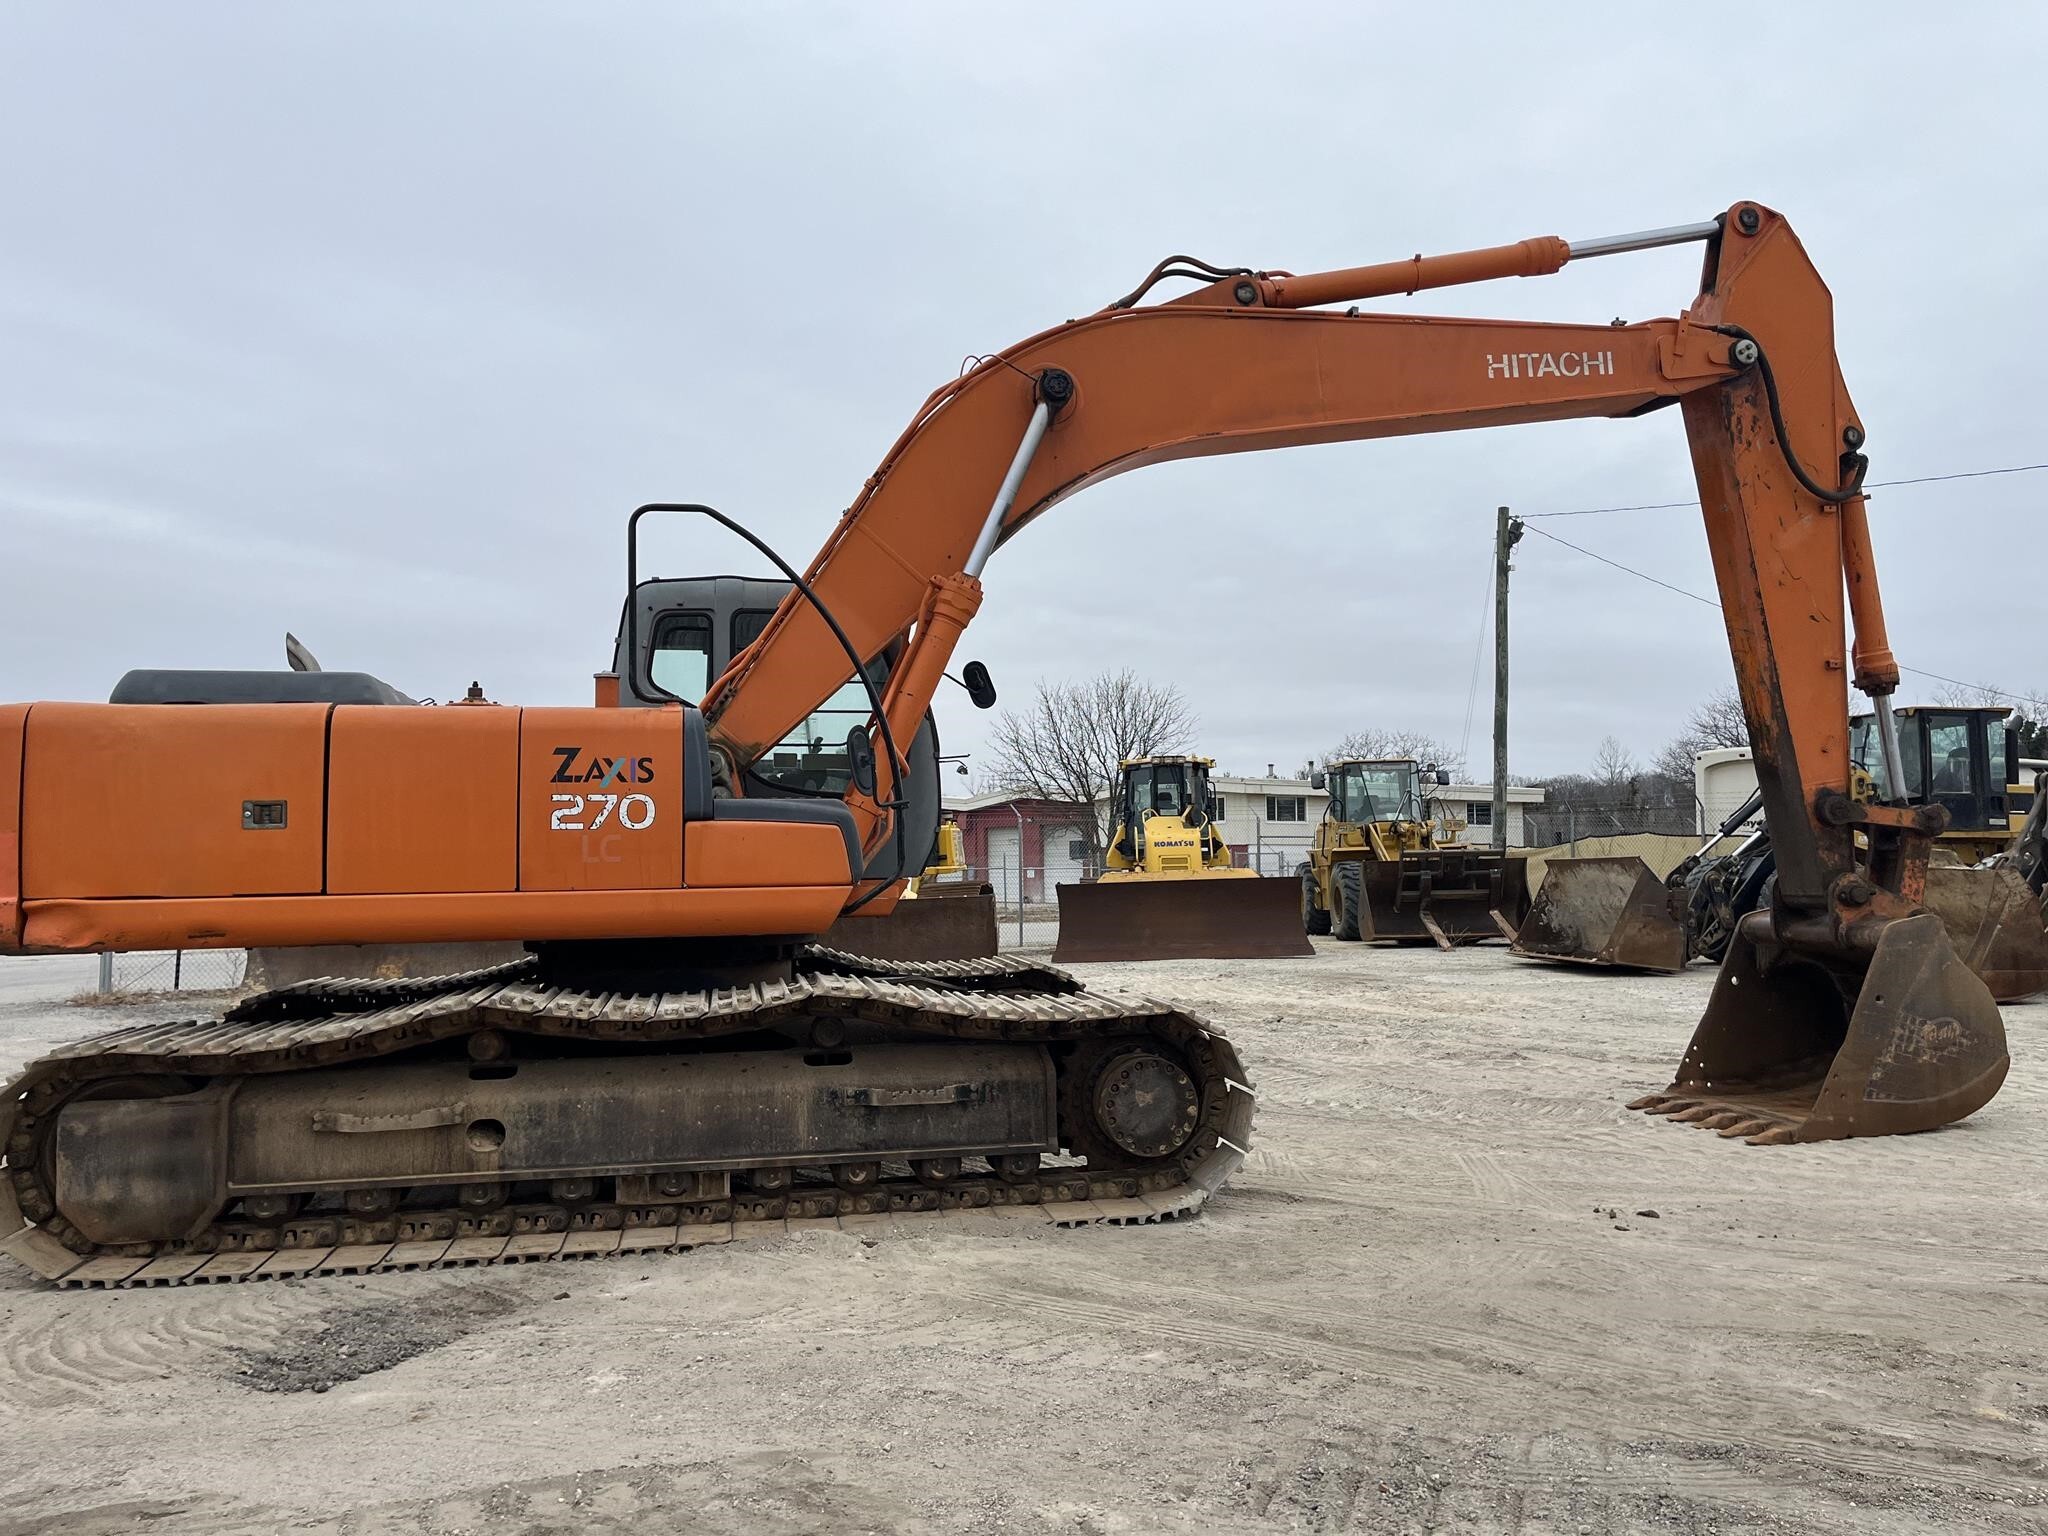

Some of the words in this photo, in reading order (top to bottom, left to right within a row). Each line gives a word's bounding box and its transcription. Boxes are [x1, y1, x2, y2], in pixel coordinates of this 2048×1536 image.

[1487, 351, 1614, 379] HITACHI
[550, 747, 655, 787] ZAXIS
[550, 793, 656, 830] 270
[582, 835, 622, 862] LC
[1153, 840, 1195, 848] KOMATSU
